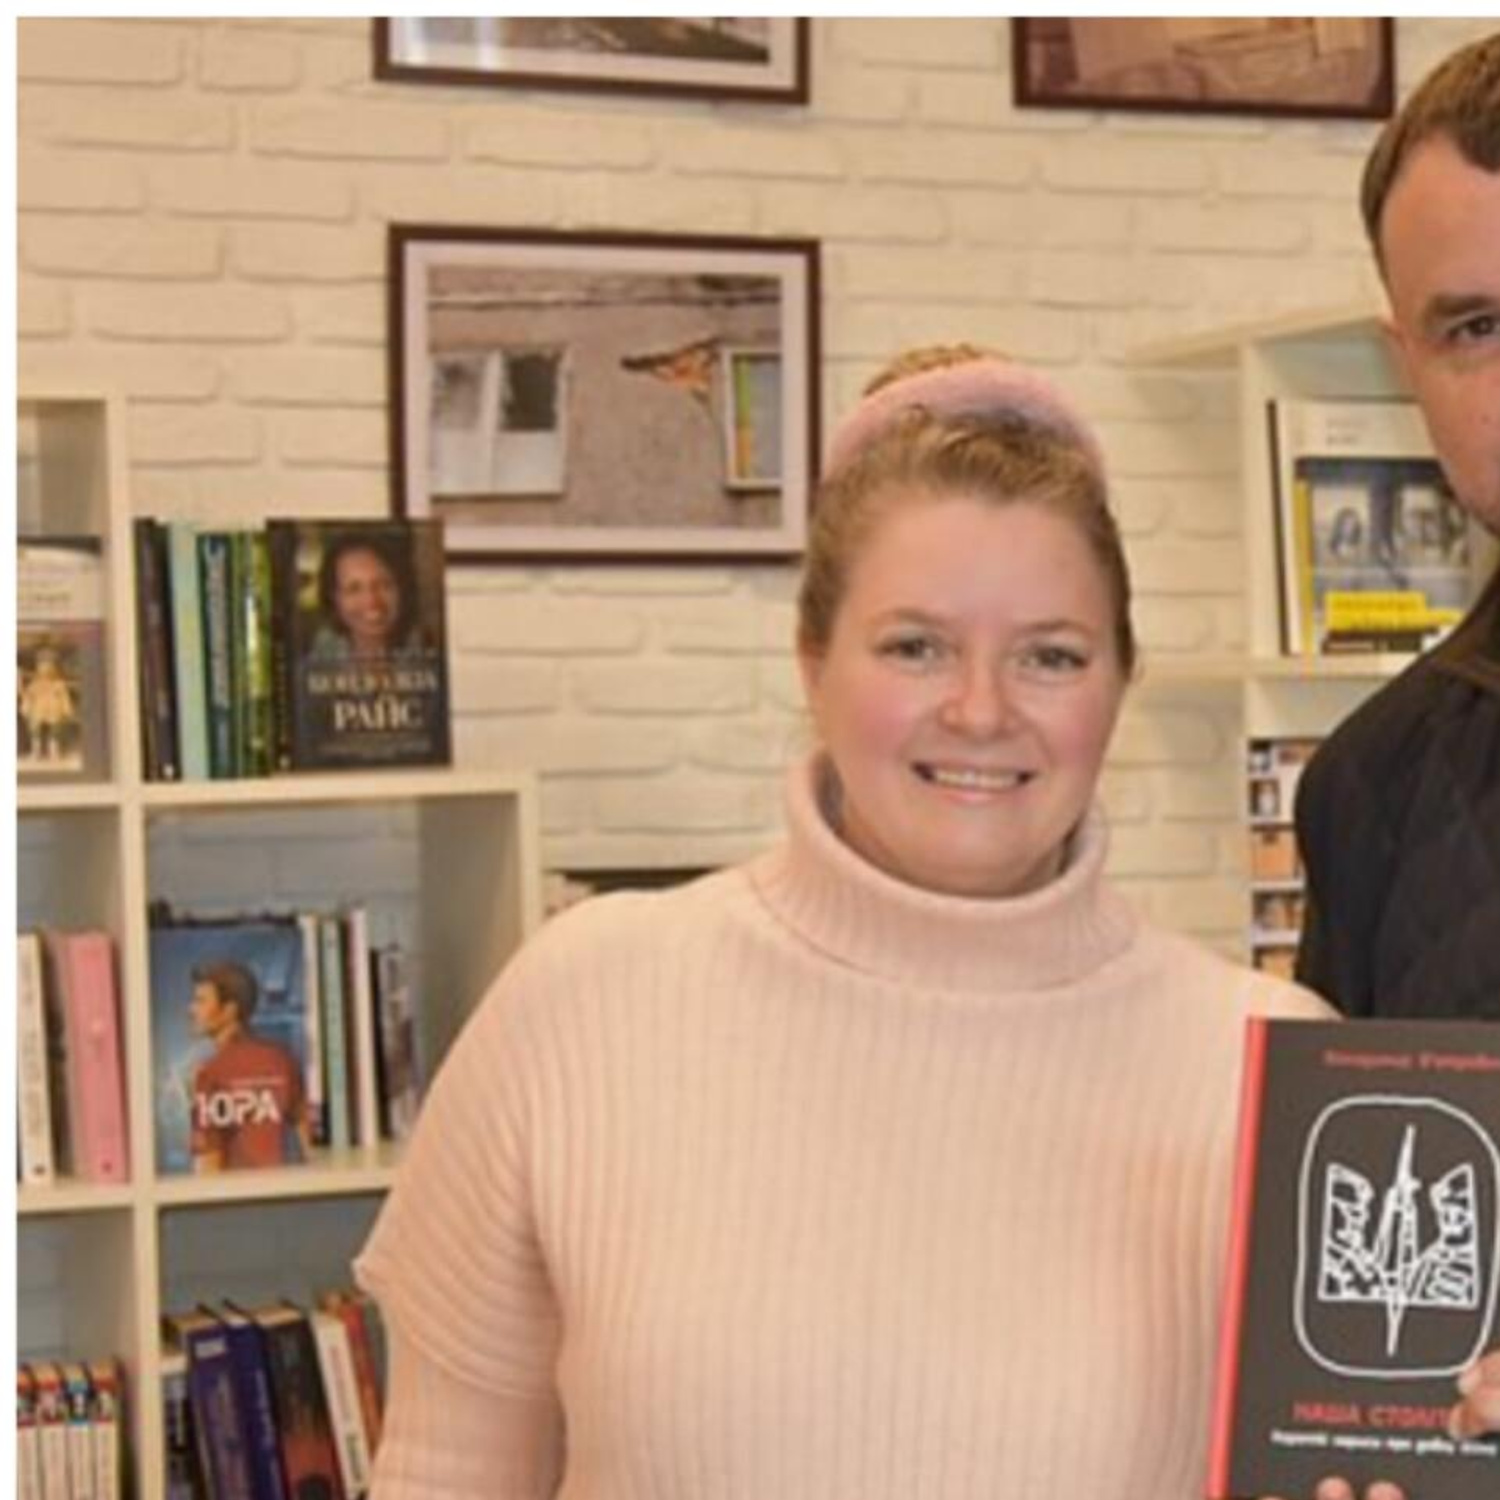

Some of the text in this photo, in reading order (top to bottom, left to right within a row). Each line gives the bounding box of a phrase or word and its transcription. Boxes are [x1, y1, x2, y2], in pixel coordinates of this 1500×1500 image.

[334, 693, 423, 731] РАЙС
[198, 1089, 283, 1128] ЮРА
[1293, 1401, 1362, 1425] НАША
